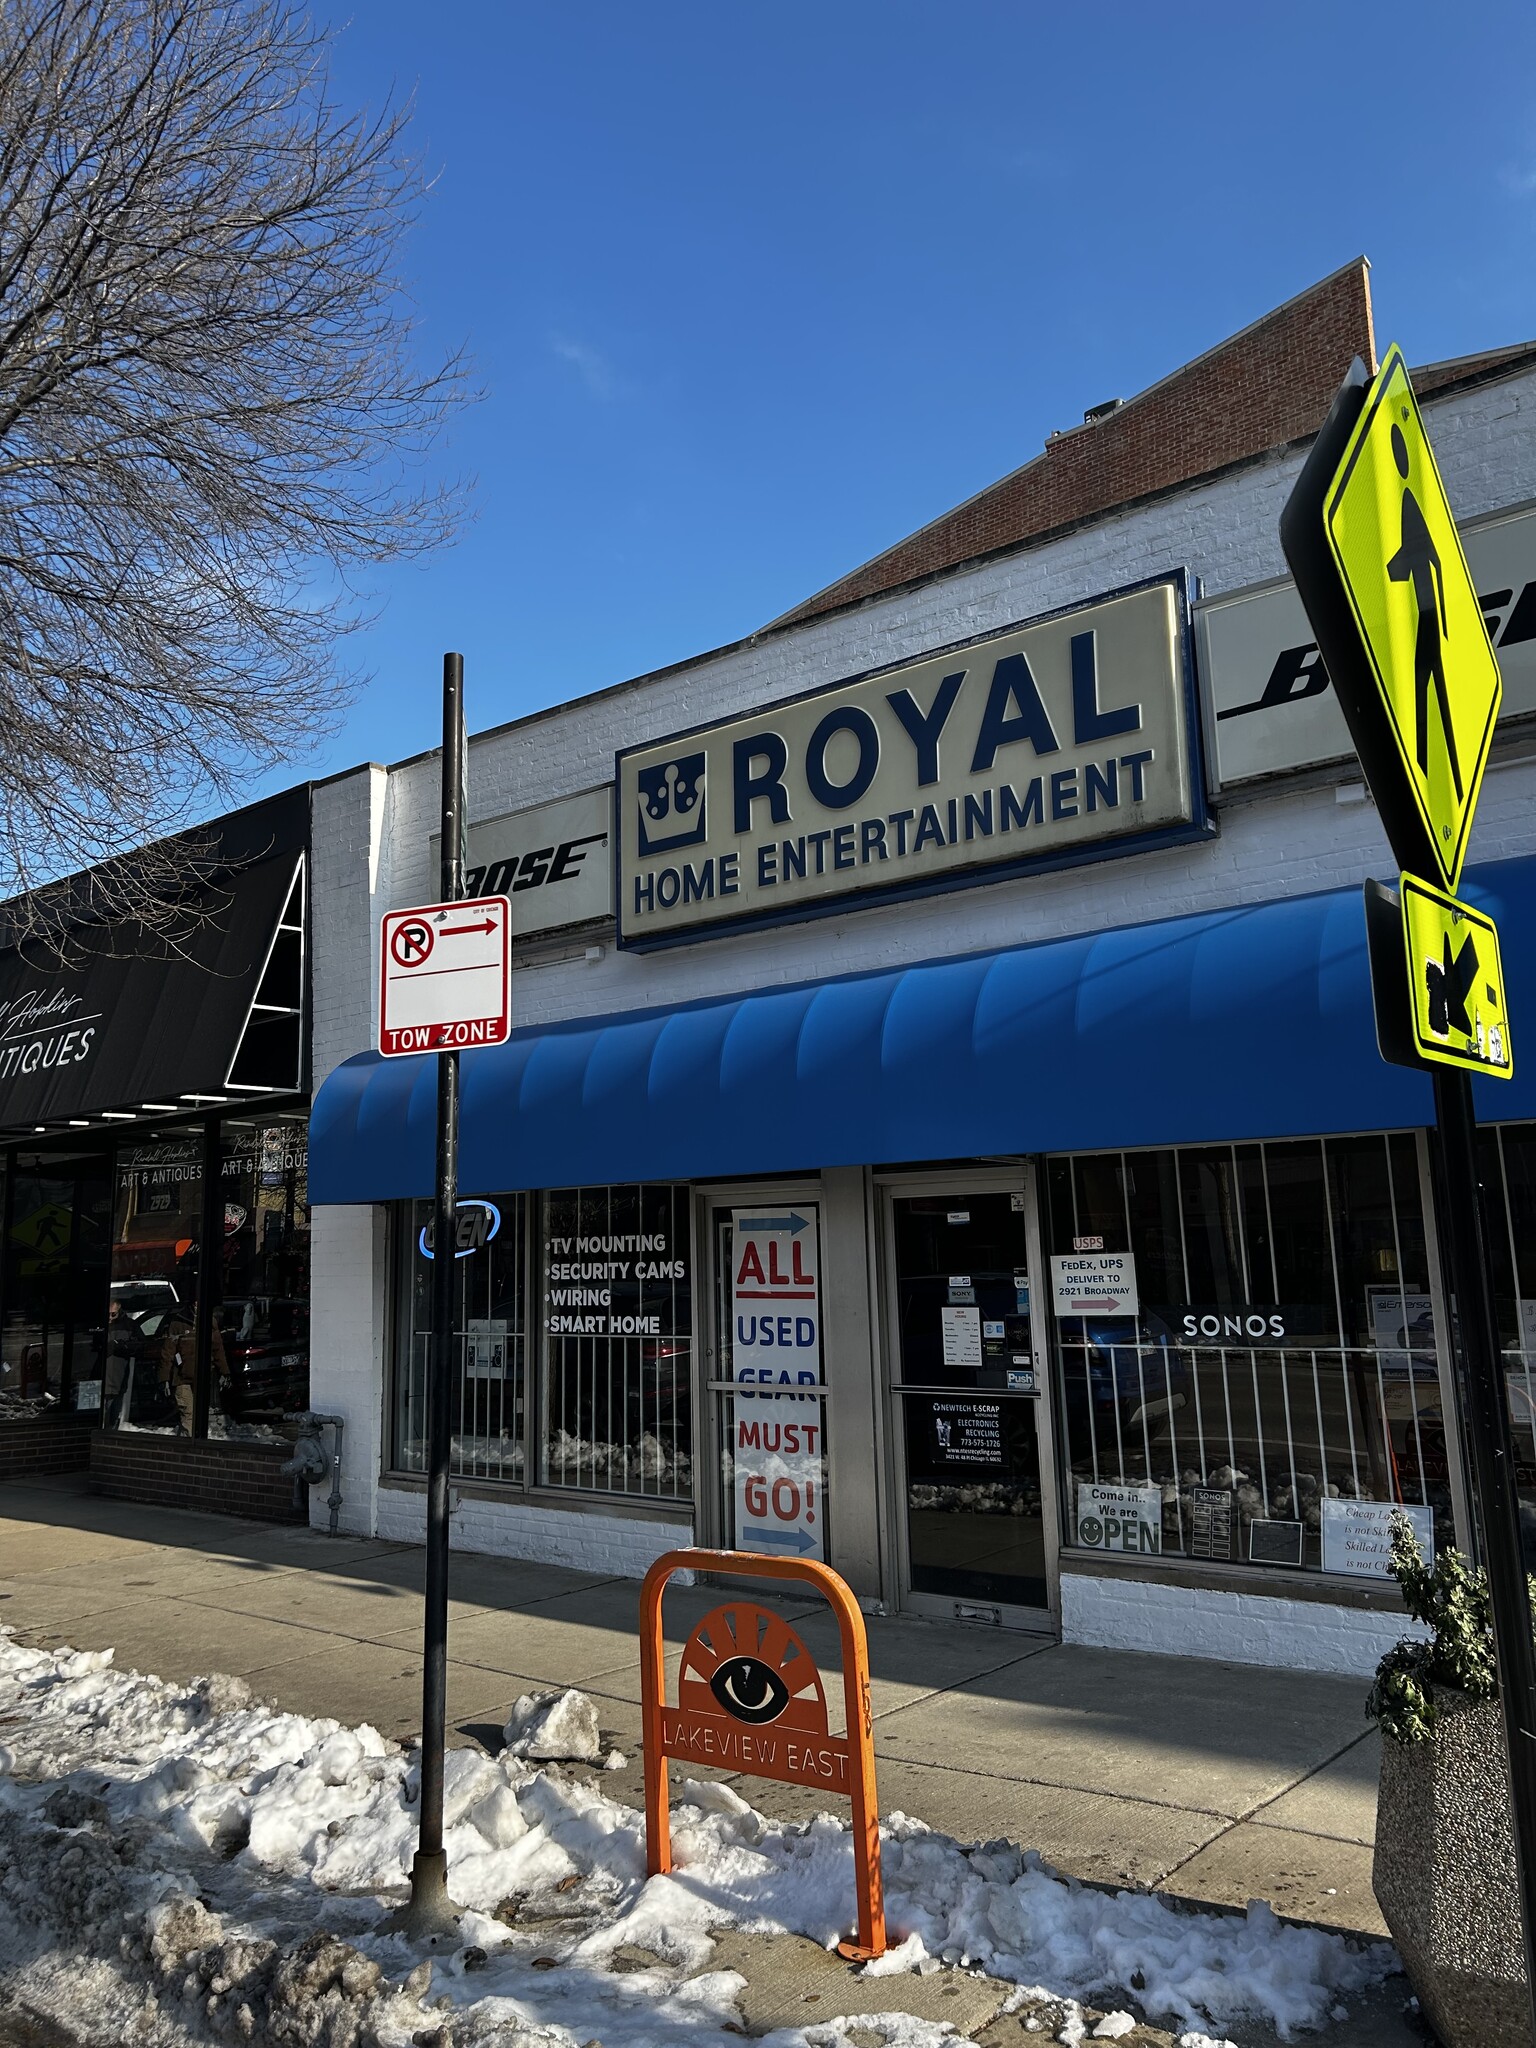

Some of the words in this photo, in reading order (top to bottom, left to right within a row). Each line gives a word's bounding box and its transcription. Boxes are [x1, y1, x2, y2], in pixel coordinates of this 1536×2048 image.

[733, 630, 1141, 835] ROYAL
[634, 852, 740, 915] HOME
[758, 749, 1153, 888] ENTERTAINMENT
[389, 1027, 430, 1050] TOW
[443, 1020, 499, 1045] ZONE
[0, 1027, 96, 1079] TIQUES
[220, 1160, 242, 1176] ART
[246, 1159, 253, 1173] &
[121, 1173, 139, 1188] ART
[142, 1172, 148, 1185] &
[151, 1165, 203, 1184] ANTIQUES
[425, 1213, 490, 1248] OEN
[551, 1237, 572, 1254] TV
[576, 1234, 666, 1253] MOUNTING
[1074, 1237, 1103, 1249] USPS
[550, 1262, 630, 1280] SECURITY
[635, 1260, 685, 1279] CAMS
[736, 1240, 815, 1285] ALL
[1100, 1259, 1124, 1269] UPS
[1066, 1275, 1104, 1284] DELIVER
[1107, 1274, 1121, 1283] TO
[551, 1288, 611, 1306] WIRING
[1059, 1287, 1081, 1296] 2921
[550, 1315, 606, 1333] SMART
[611, 1316, 660, 1334] HOME
[737, 1316, 815, 1347] USED
[1183, 1315, 1285, 1338] SONOS
[738, 1368, 816, 1402] GEAR
[1008, 1373, 1032, 1384] Push
[940, 1404, 971, 1412] NEWTECH
[957, 1418, 999, 1428] ELECTRONICS
[738, 1420, 819, 1454] MUST
[965, 1428, 1000, 1437] RECYCLING
[960, 1438, 1001, 1447] 773-575-1726
[745, 1475, 815, 1524] GO!
[1091, 1488, 1124, 1501] Come
[1128, 1491, 1146, 1503] in..
[1198, 1492, 1226, 1501] SONOS
[1099, 1504, 1117, 1516] We
[1119, 1508, 1138, 1518] are
[1345, 1507, 1376, 1521] Cheap
[1344, 1525, 1352, 1533] is
[1354, 1527, 1369, 1535] not
[1345, 1540, 1377, 1553] Skilled
[1346, 1558, 1354, 1567] is
[1356, 1561, 1372, 1569] not
[663, 1720, 777, 1764] LAKEVIEW
[787, 1743, 849, 1779] EAST
